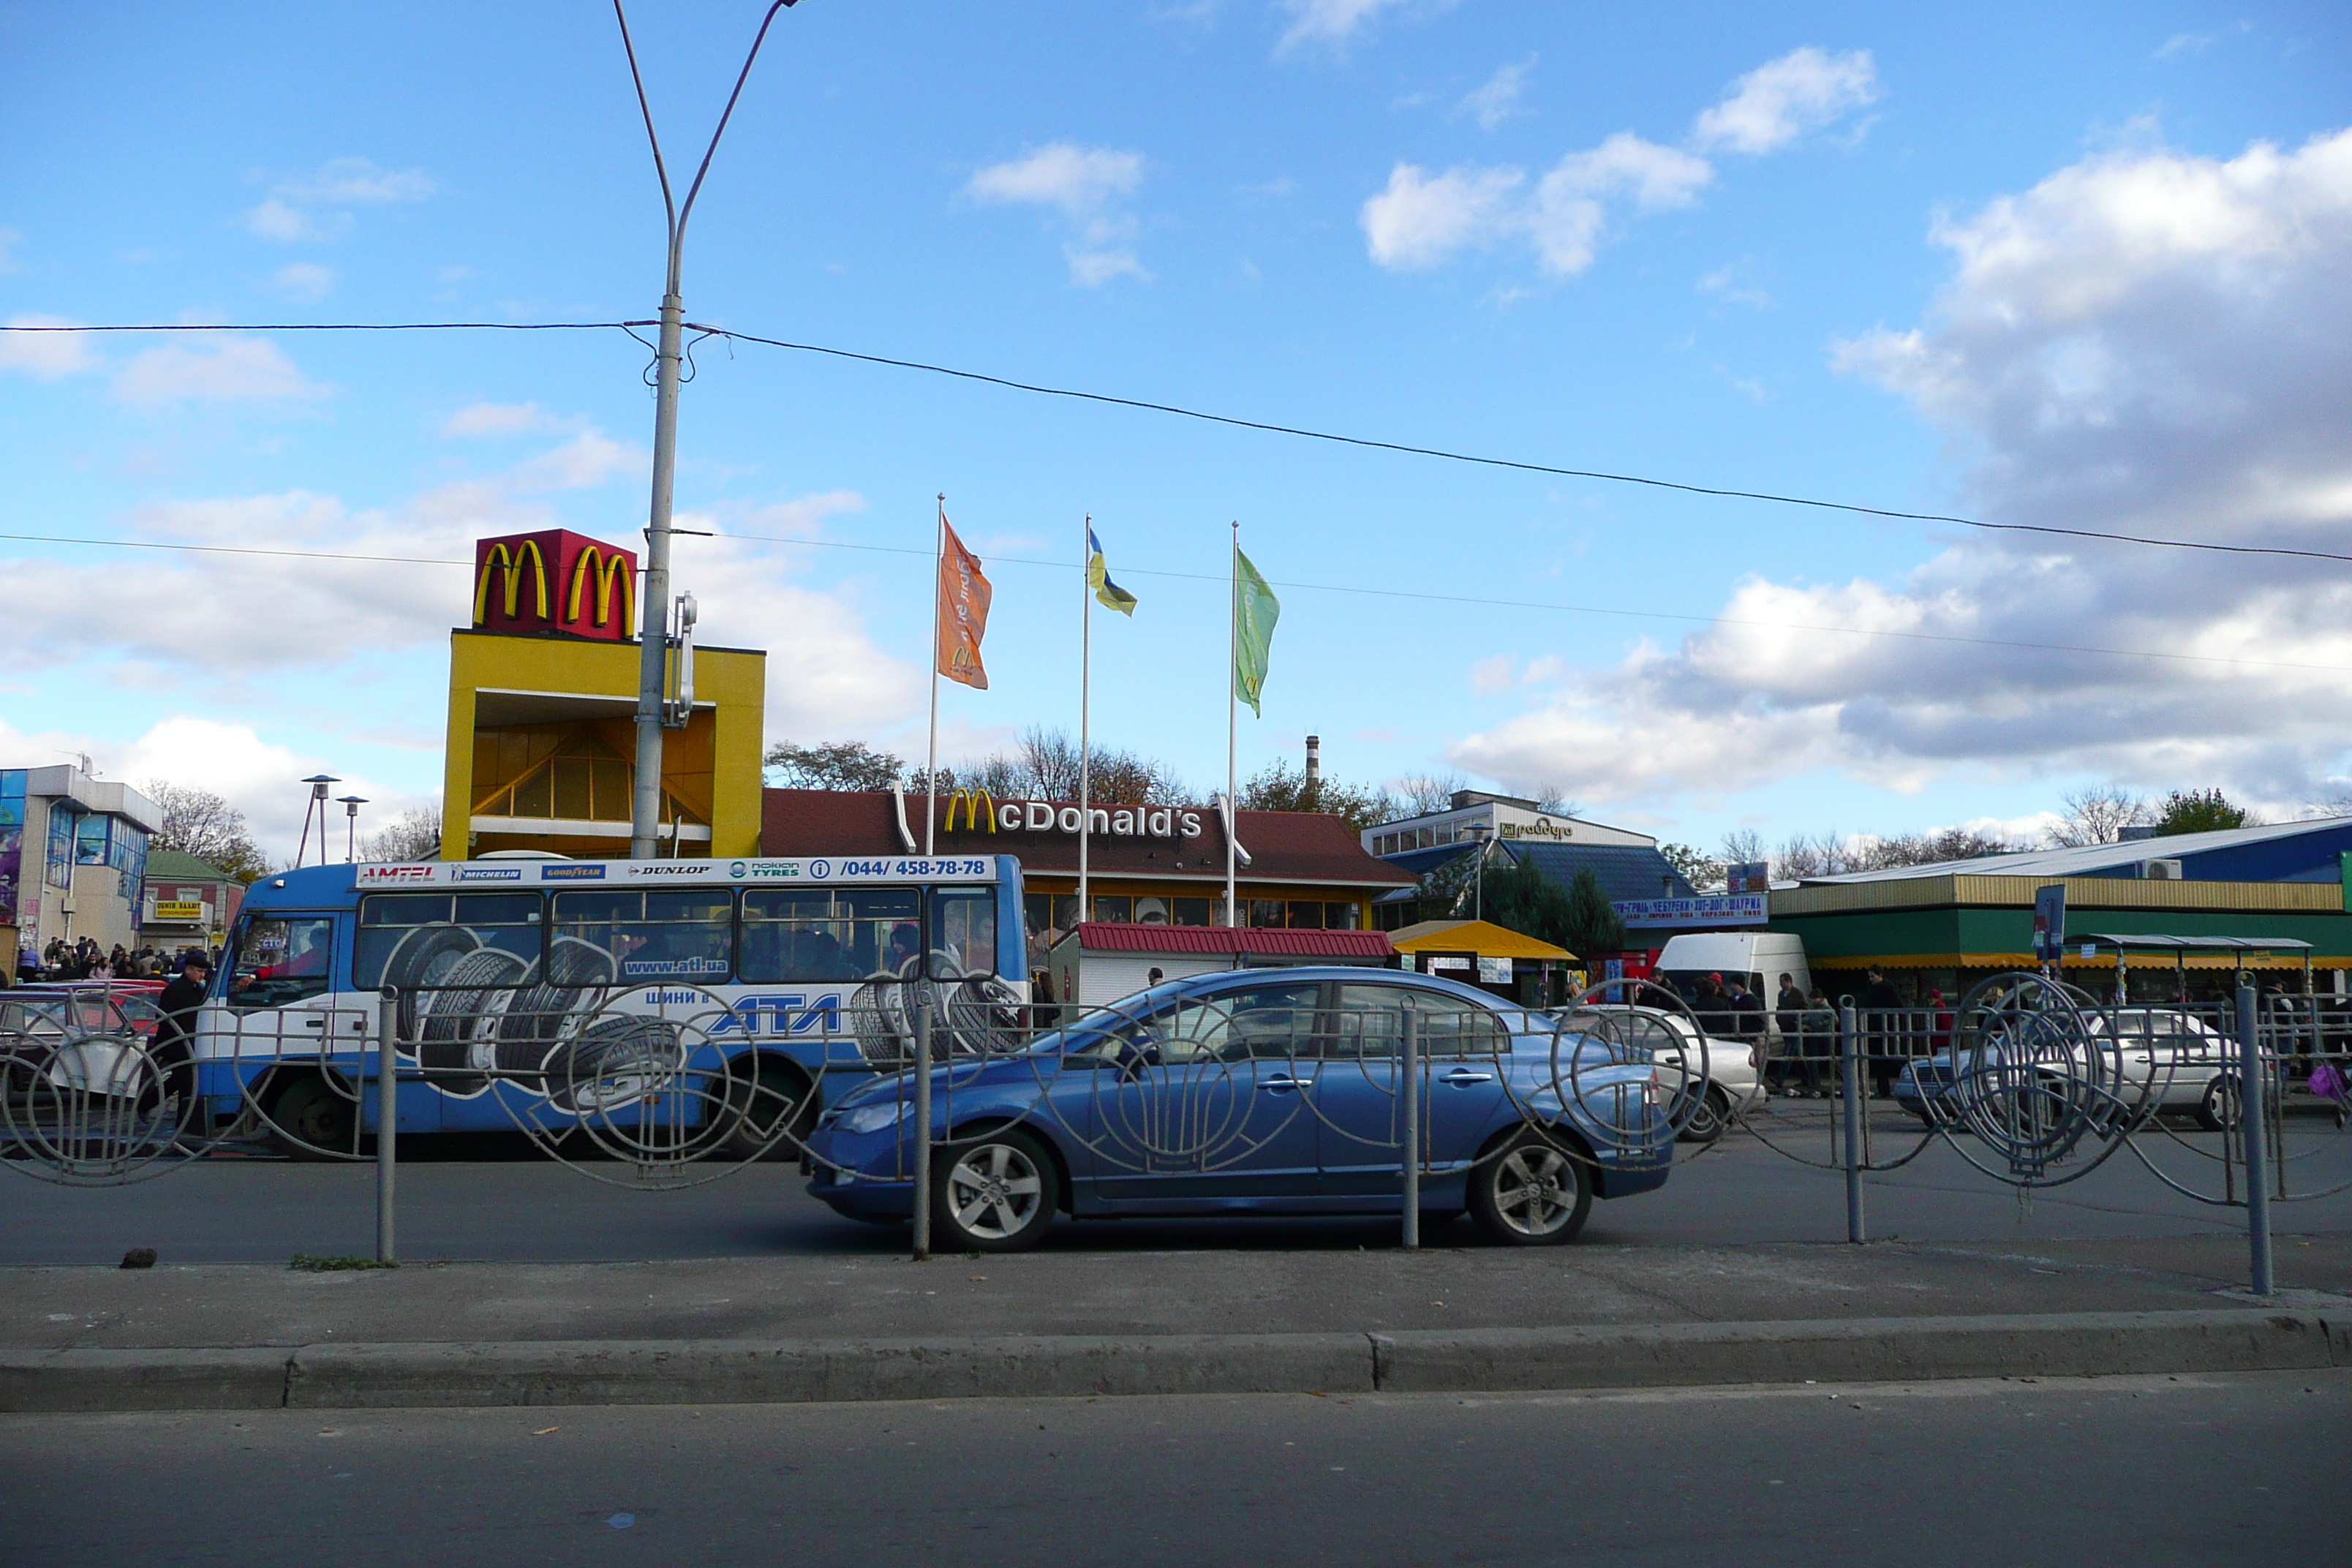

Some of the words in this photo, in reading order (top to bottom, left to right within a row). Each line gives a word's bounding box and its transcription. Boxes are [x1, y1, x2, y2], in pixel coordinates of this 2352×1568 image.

[944, 787, 1202, 838] McDonald's
[465, 870, 520, 878] MICHELIN
[641, 866, 709, 875] DUNLOP
[752, 869, 799, 877] TYRES
[840, 861, 891, 875] /044/
[896, 860, 985, 875] 458-78-78
[359, 867, 436, 883] AMTEL
[1653, 900, 1689, 913] ЧЕБУРЕКИ
[1695, 898, 1725, 911] ХОТ-ДОГ
[1729, 897, 1761, 911] ШАУРМА
[263, 939, 281, 947] СТО
[625, 957, 728, 975] www.atl.ua
[646, 992, 696, 1004] ШИНИ
